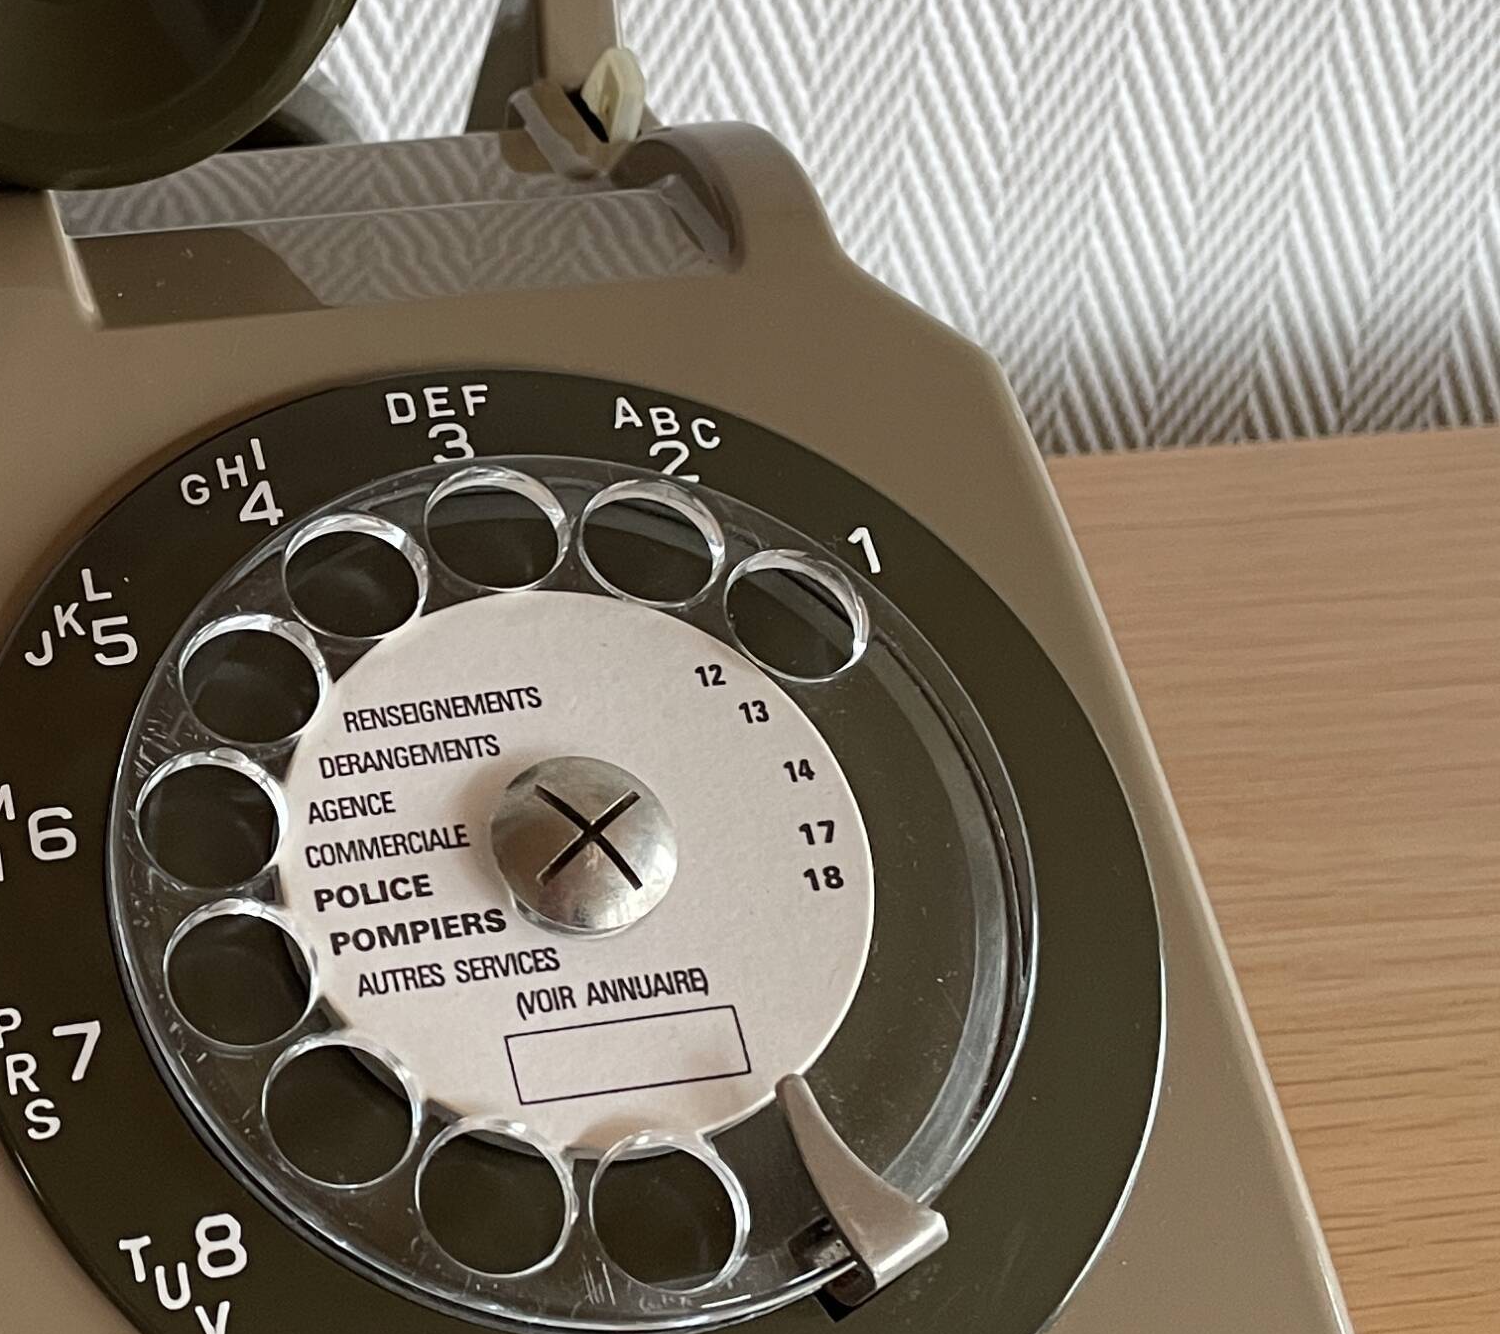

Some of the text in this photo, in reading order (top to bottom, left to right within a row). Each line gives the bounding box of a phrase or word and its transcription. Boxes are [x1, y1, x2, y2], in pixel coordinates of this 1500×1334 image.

[386, 385, 488, 425] DEF
[613, 396, 722, 450] ABC
[426, 420, 474, 466] 3
[647, 439, 700, 485] 2
[238, 479, 284, 527] 4
[846, 525, 882, 575] 1
[92, 614, 138, 667] 5
[695, 662, 726, 688] 12
[344, 686, 542, 733] RENSEIGNEMENTS
[738, 699, 770, 725] 13
[318, 734, 501, 779] DERANGEMENTS
[783, 758, 815, 784] 14
[307, 790, 396, 825] AGENCE
[27, 806, 78, 861] 6
[304, 824, 471, 869] COMMERCIALE
[799, 819, 836, 846] 17
[313, 873, 434, 913] POLICE
[803, 865, 845, 892] 18
[330, 908, 508, 957] POMPIERS
[357, 947, 561, 998] AUTRES SERVICES
[516, 966, 710, 1021] (VOIR ANNUAIRE)
[52, 1020, 102, 1081] 7
[194, 1212, 248, 1279] 8
